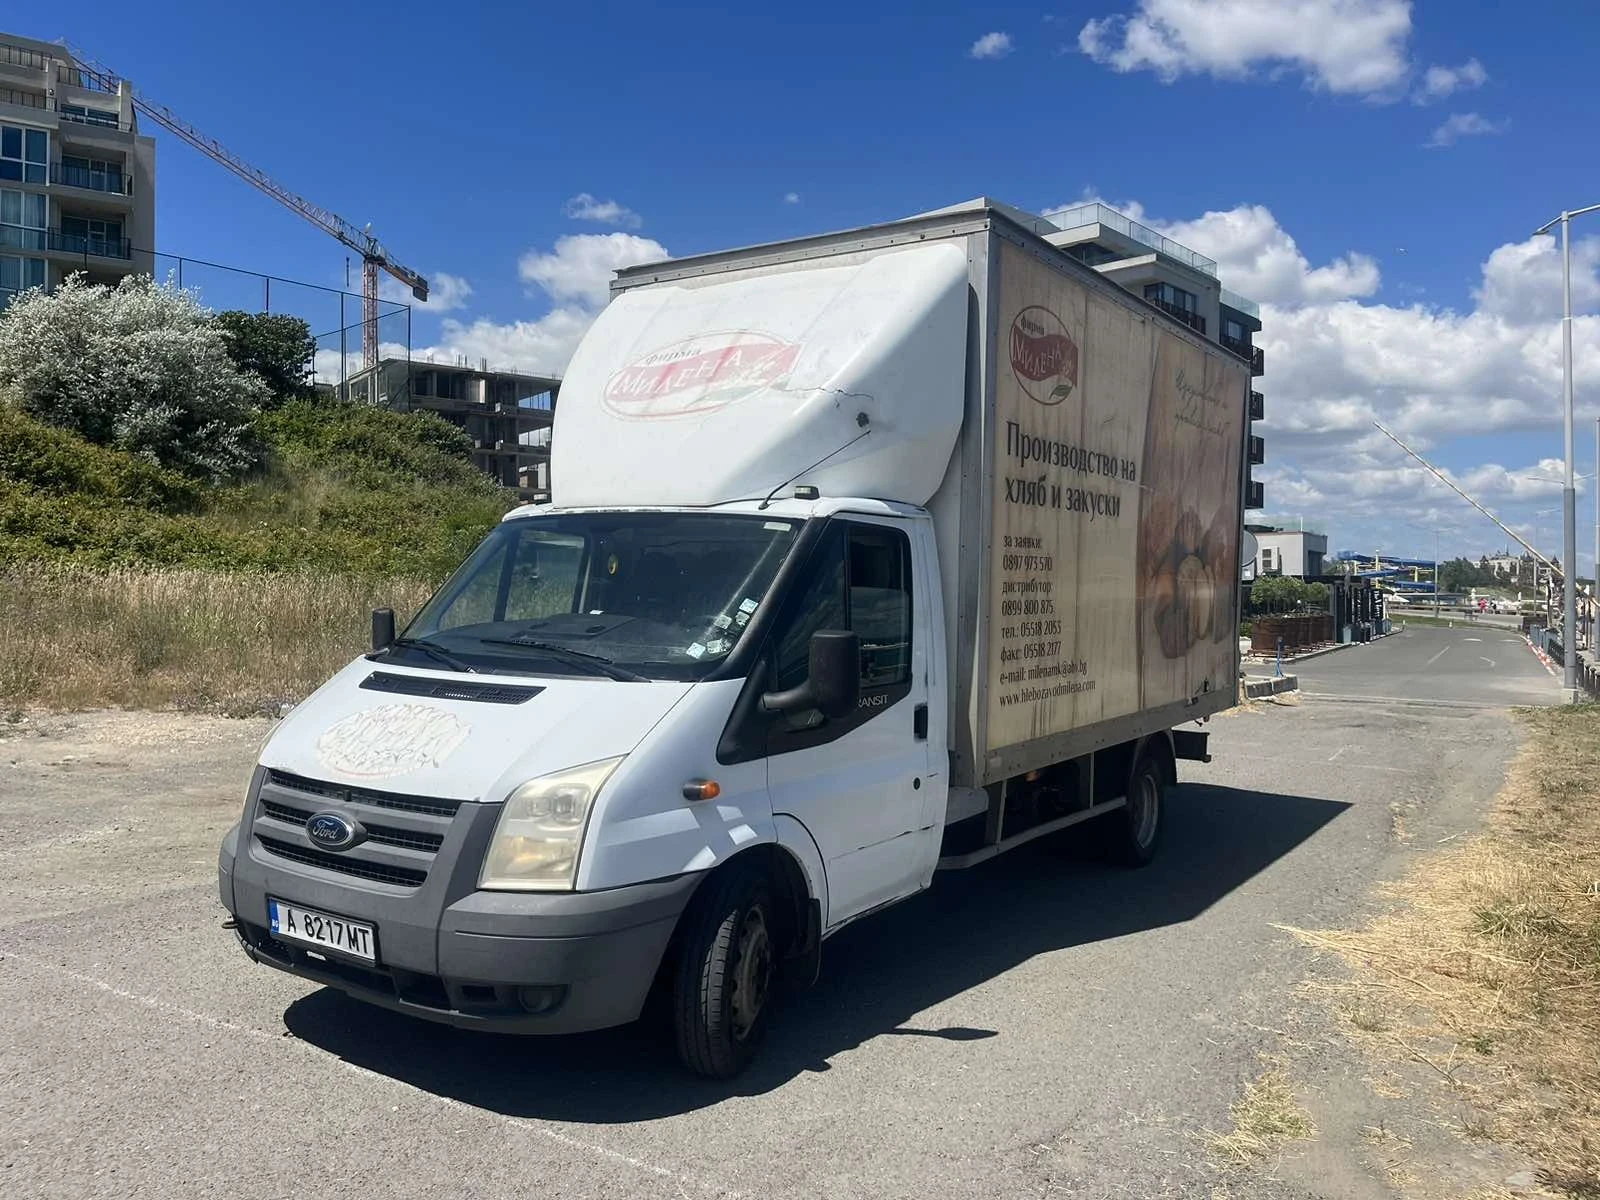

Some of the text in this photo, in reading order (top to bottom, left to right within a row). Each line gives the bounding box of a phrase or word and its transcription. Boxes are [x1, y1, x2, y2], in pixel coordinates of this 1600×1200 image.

[1006, 420, 1136, 482] Производство на
[1005, 474, 1120, 521] хляб и закуски
[1003, 535, 1013, 548] за
[1003, 554, 1053, 571] 0897 973 570
[1002, 599, 1054, 616] 0899 800 875
[1020, 621, 1042, 638] 05518
[1023, 643, 1046, 660] 05518
[1046, 640, 1062, 657] 2177
[312, 819, 339, 839] Ford
[287, 909, 296, 933] A
[303, 913, 344, 945] 8217
